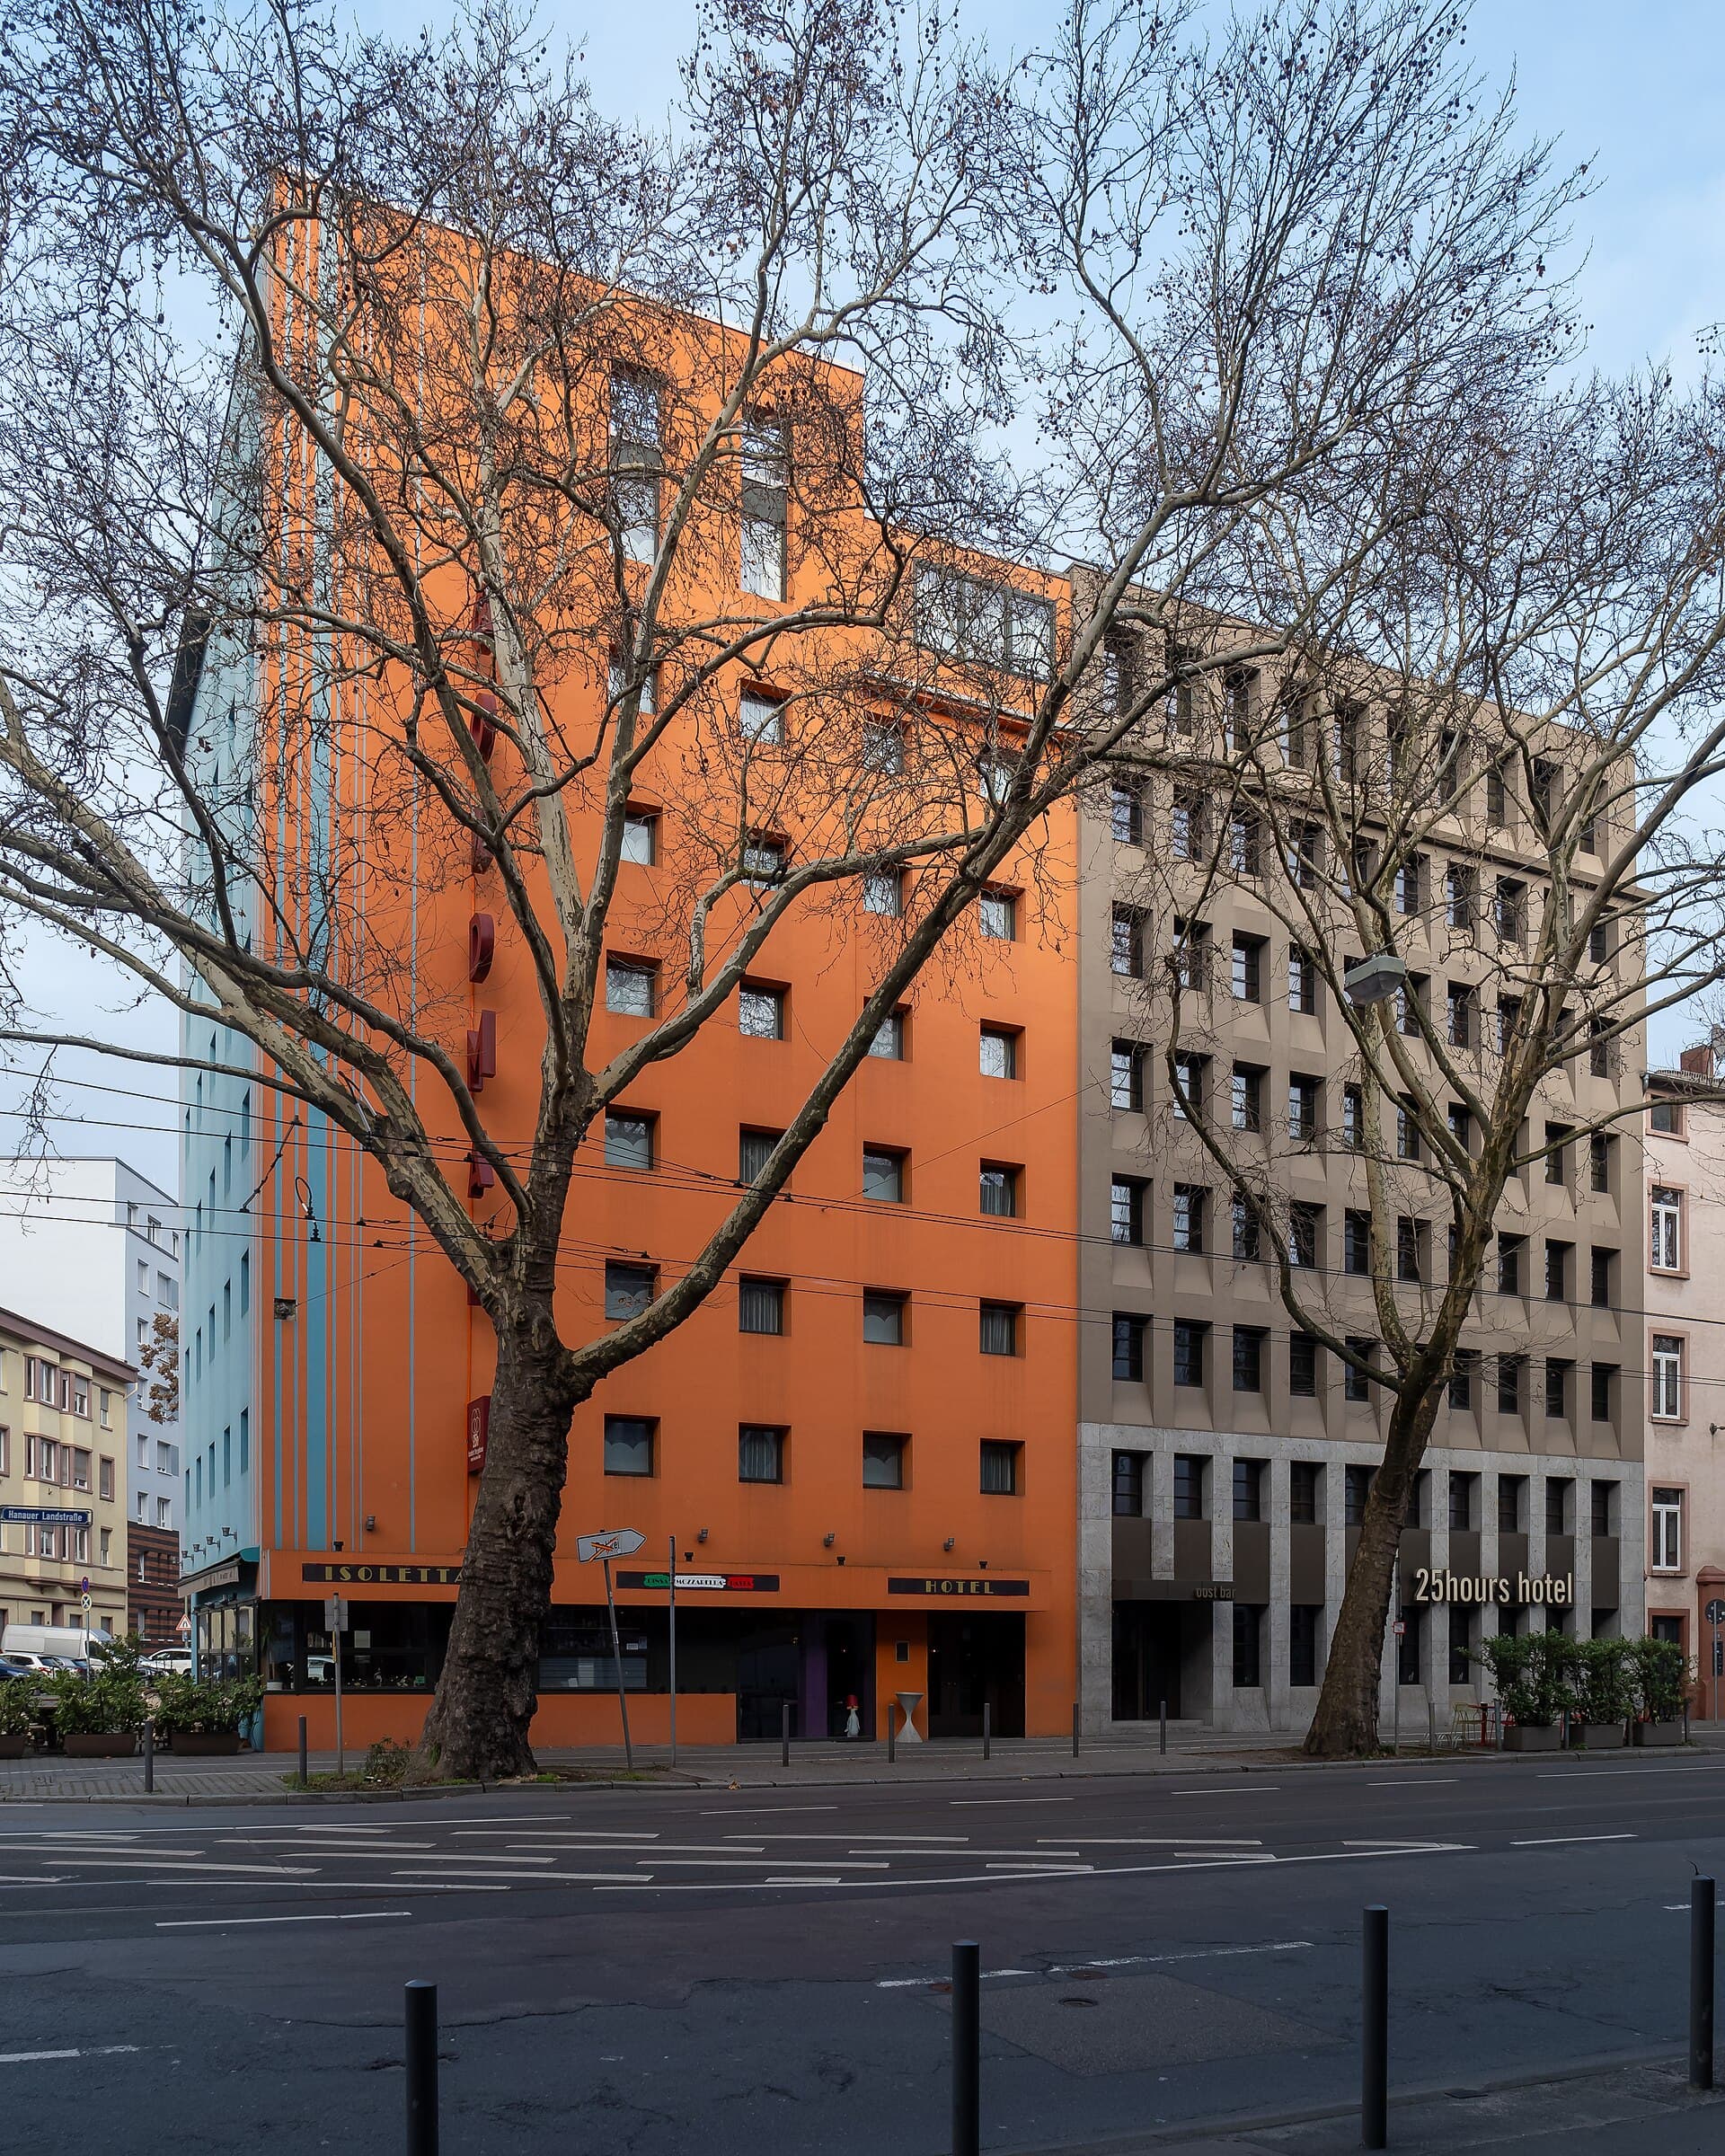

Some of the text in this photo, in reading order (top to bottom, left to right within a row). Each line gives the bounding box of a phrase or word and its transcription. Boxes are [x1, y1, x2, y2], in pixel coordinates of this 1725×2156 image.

[8, 1510, 83, 1522] Hanauer Landstraße
[925, 1580, 994, 1594] HOTEL
[1220, 1586, 1236, 1599] bar
[1416, 1568, 1572, 1604] 25hours hotel
